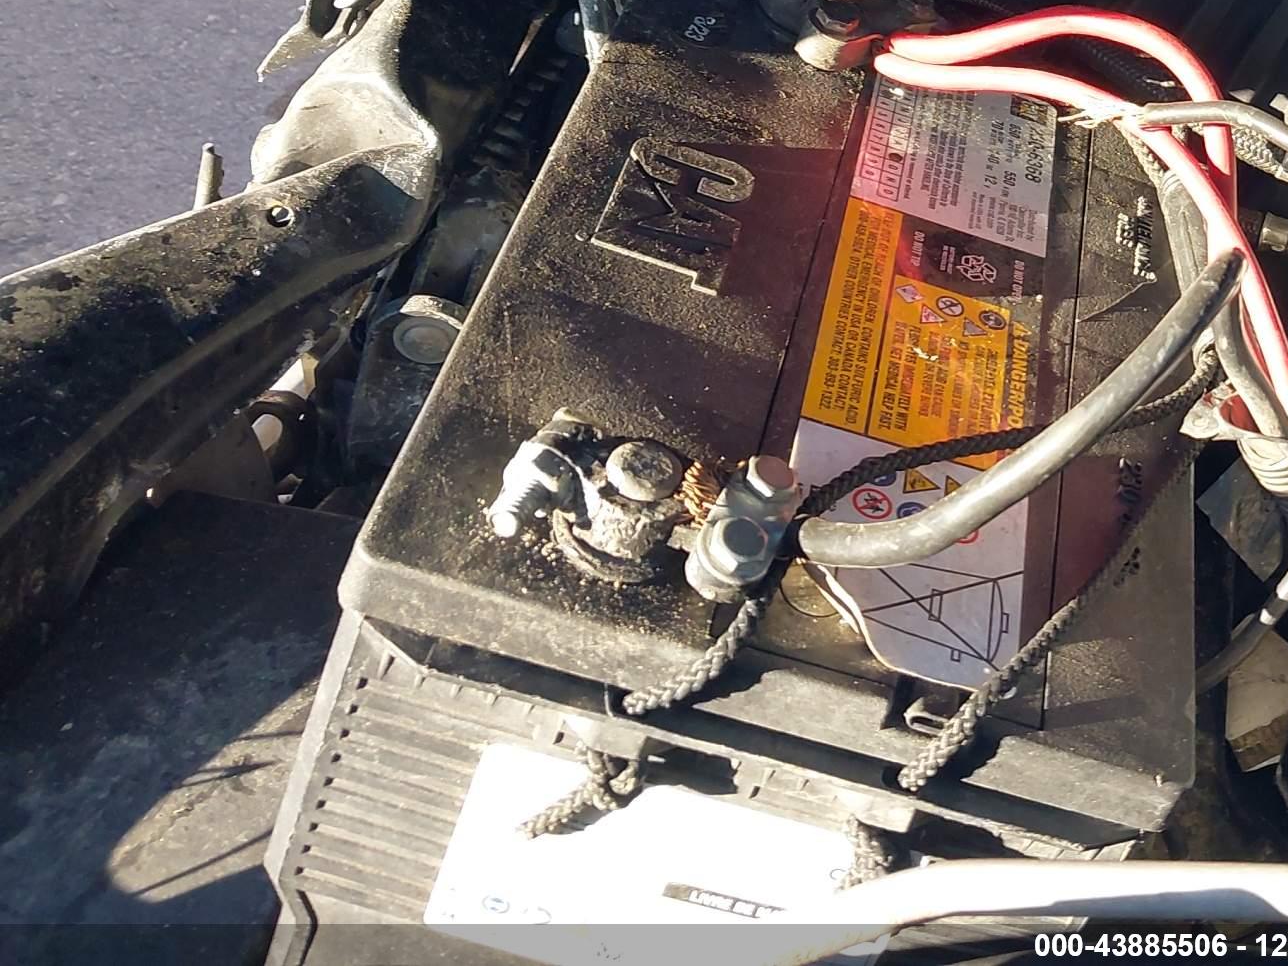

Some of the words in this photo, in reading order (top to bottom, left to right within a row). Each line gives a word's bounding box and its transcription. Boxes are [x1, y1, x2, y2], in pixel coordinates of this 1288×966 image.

[983, 174, 997, 185] 12
[1001, 170, 1016, 186] 550
[869, 216, 880, 231] FOR
[863, 230, 877, 260] MEDICAL
[881, 229, 891, 243] OUT
[914, 230, 923, 241] DO
[912, 240, 922, 255] NOT
[847, 255, 859, 279] OTHER
[910, 253, 920, 266] TIP
[1015, 259, 1024, 270] DO
[854, 260, 871, 304] EMERGENCY
[1013, 269, 1022, 284] NOT
[838, 279, 855, 320] COUNTRIES
[850, 312, 861, 329] USA
[857, 326, 873, 364] CONTAINS
[841, 341, 855, 373] CANADA
[849, 364, 865, 403] SULFURIC
[885, 360, 899, 391] MEDICAL
[1006, 339, 1030, 428] DANGER/PO
[881, 390, 894, 411] HELP
[878, 410, 891, 431] FAST.
[894, 410, 907, 432] WITH
